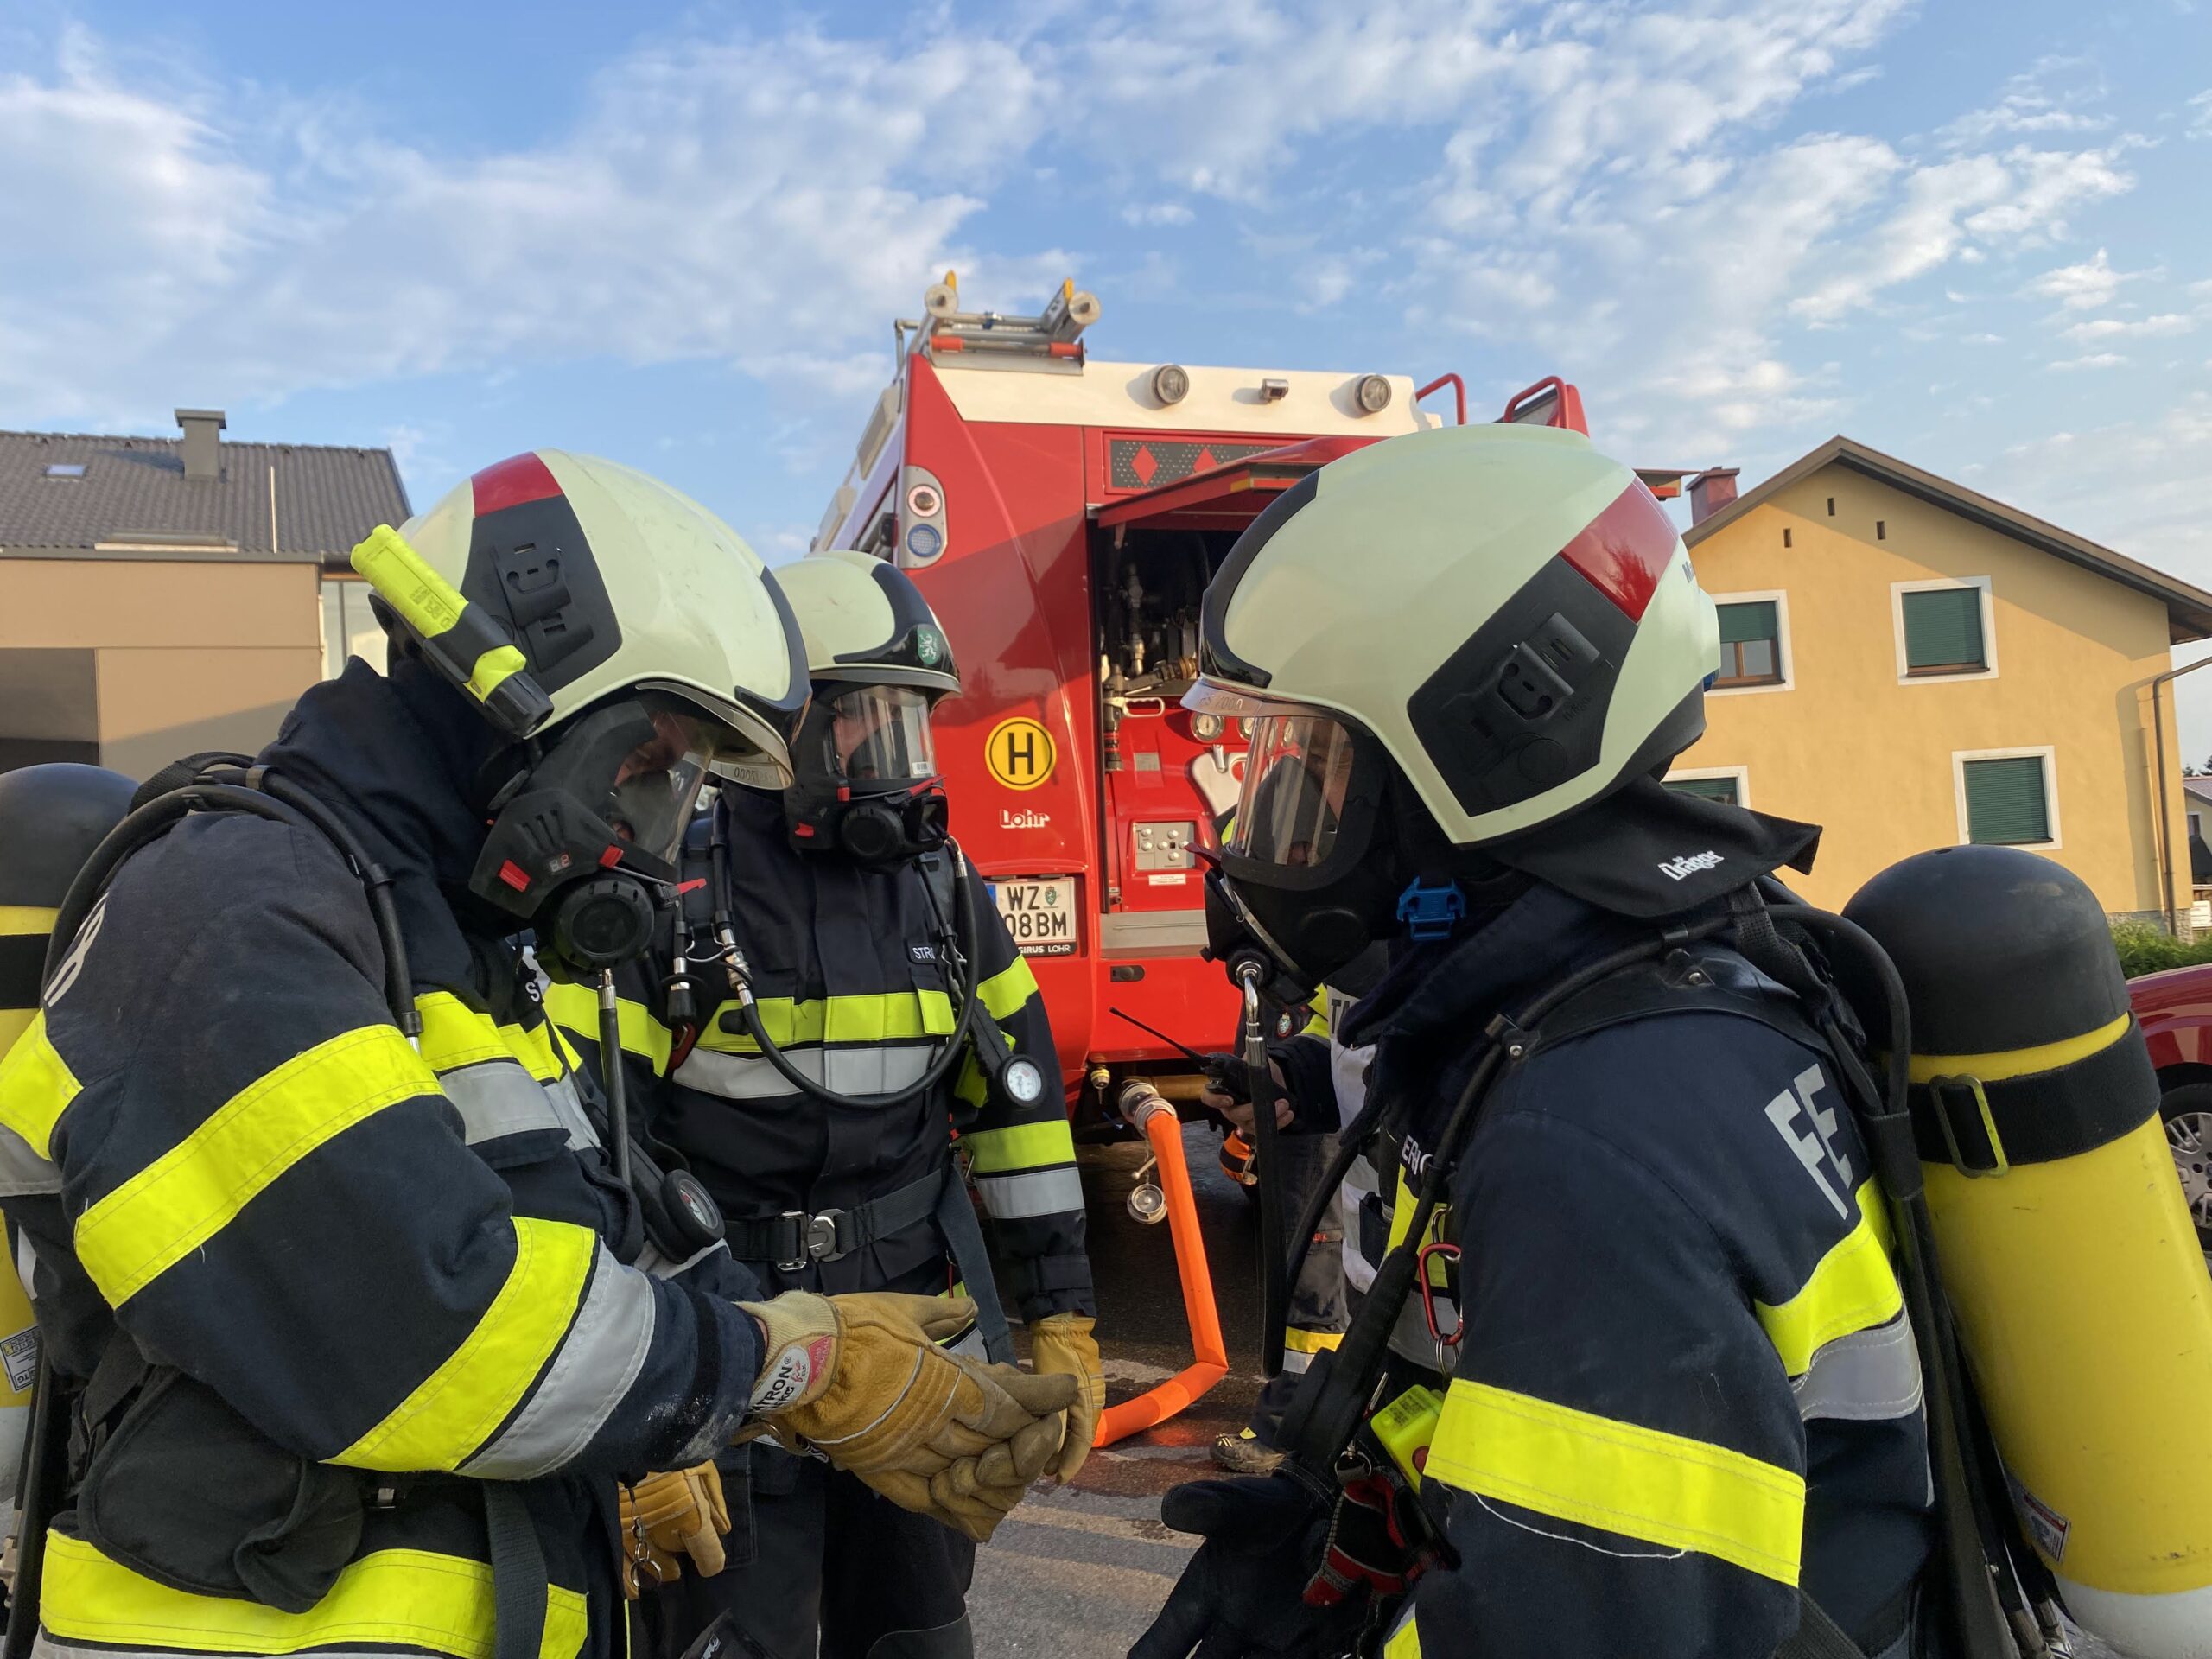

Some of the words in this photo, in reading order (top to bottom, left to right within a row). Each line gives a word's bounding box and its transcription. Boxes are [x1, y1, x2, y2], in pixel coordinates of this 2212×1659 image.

[1008, 733, 1033, 775] H
[1000, 809, 1050, 829] Lohr
[1657, 850, 1725, 881] Dräger
[1007, 886, 1040, 911] WZ
[1048, 944, 1071, 953] LOHR
